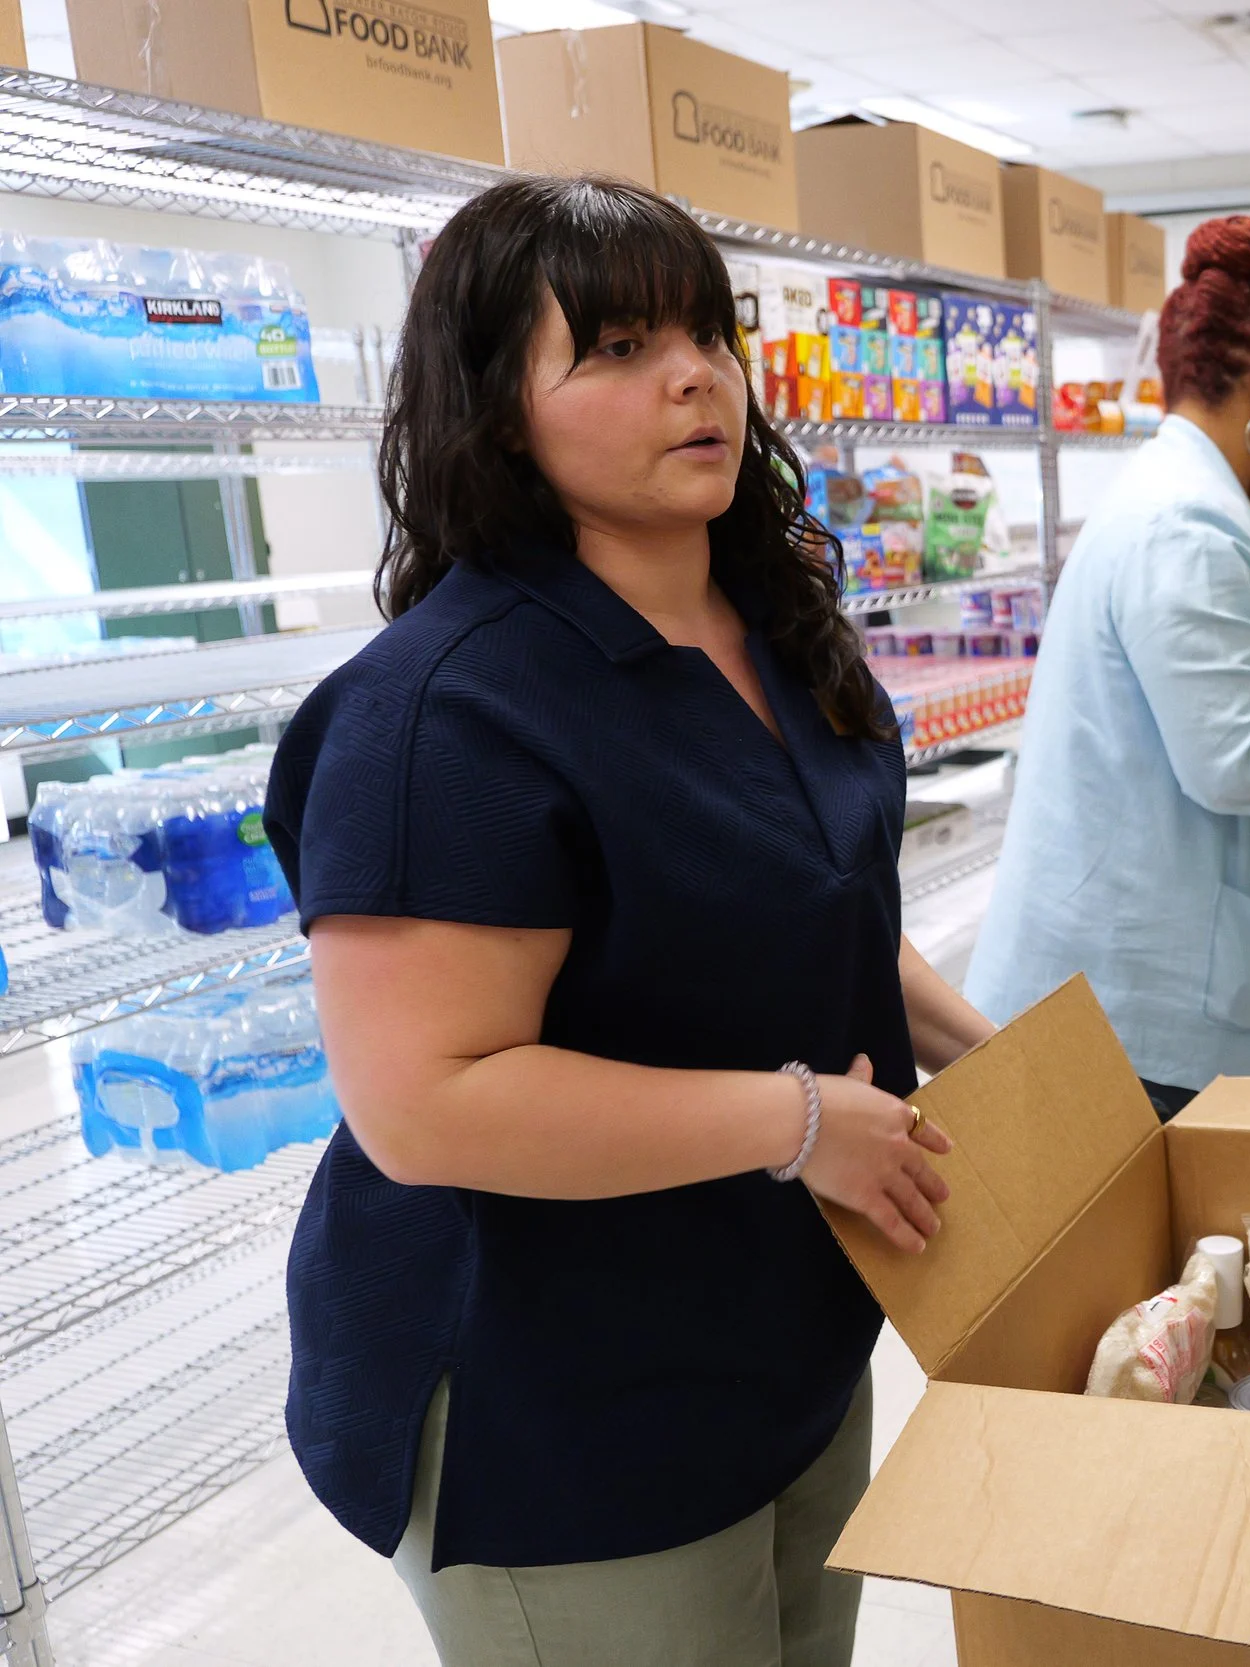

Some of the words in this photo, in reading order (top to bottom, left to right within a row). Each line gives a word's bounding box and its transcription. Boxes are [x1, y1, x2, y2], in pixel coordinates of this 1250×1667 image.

[334, 7, 409, 52] FOOD
[413, 28, 473, 71] BANK
[701, 120, 746, 154] FOOD
[147, 300, 219, 317] KIRKLAND
